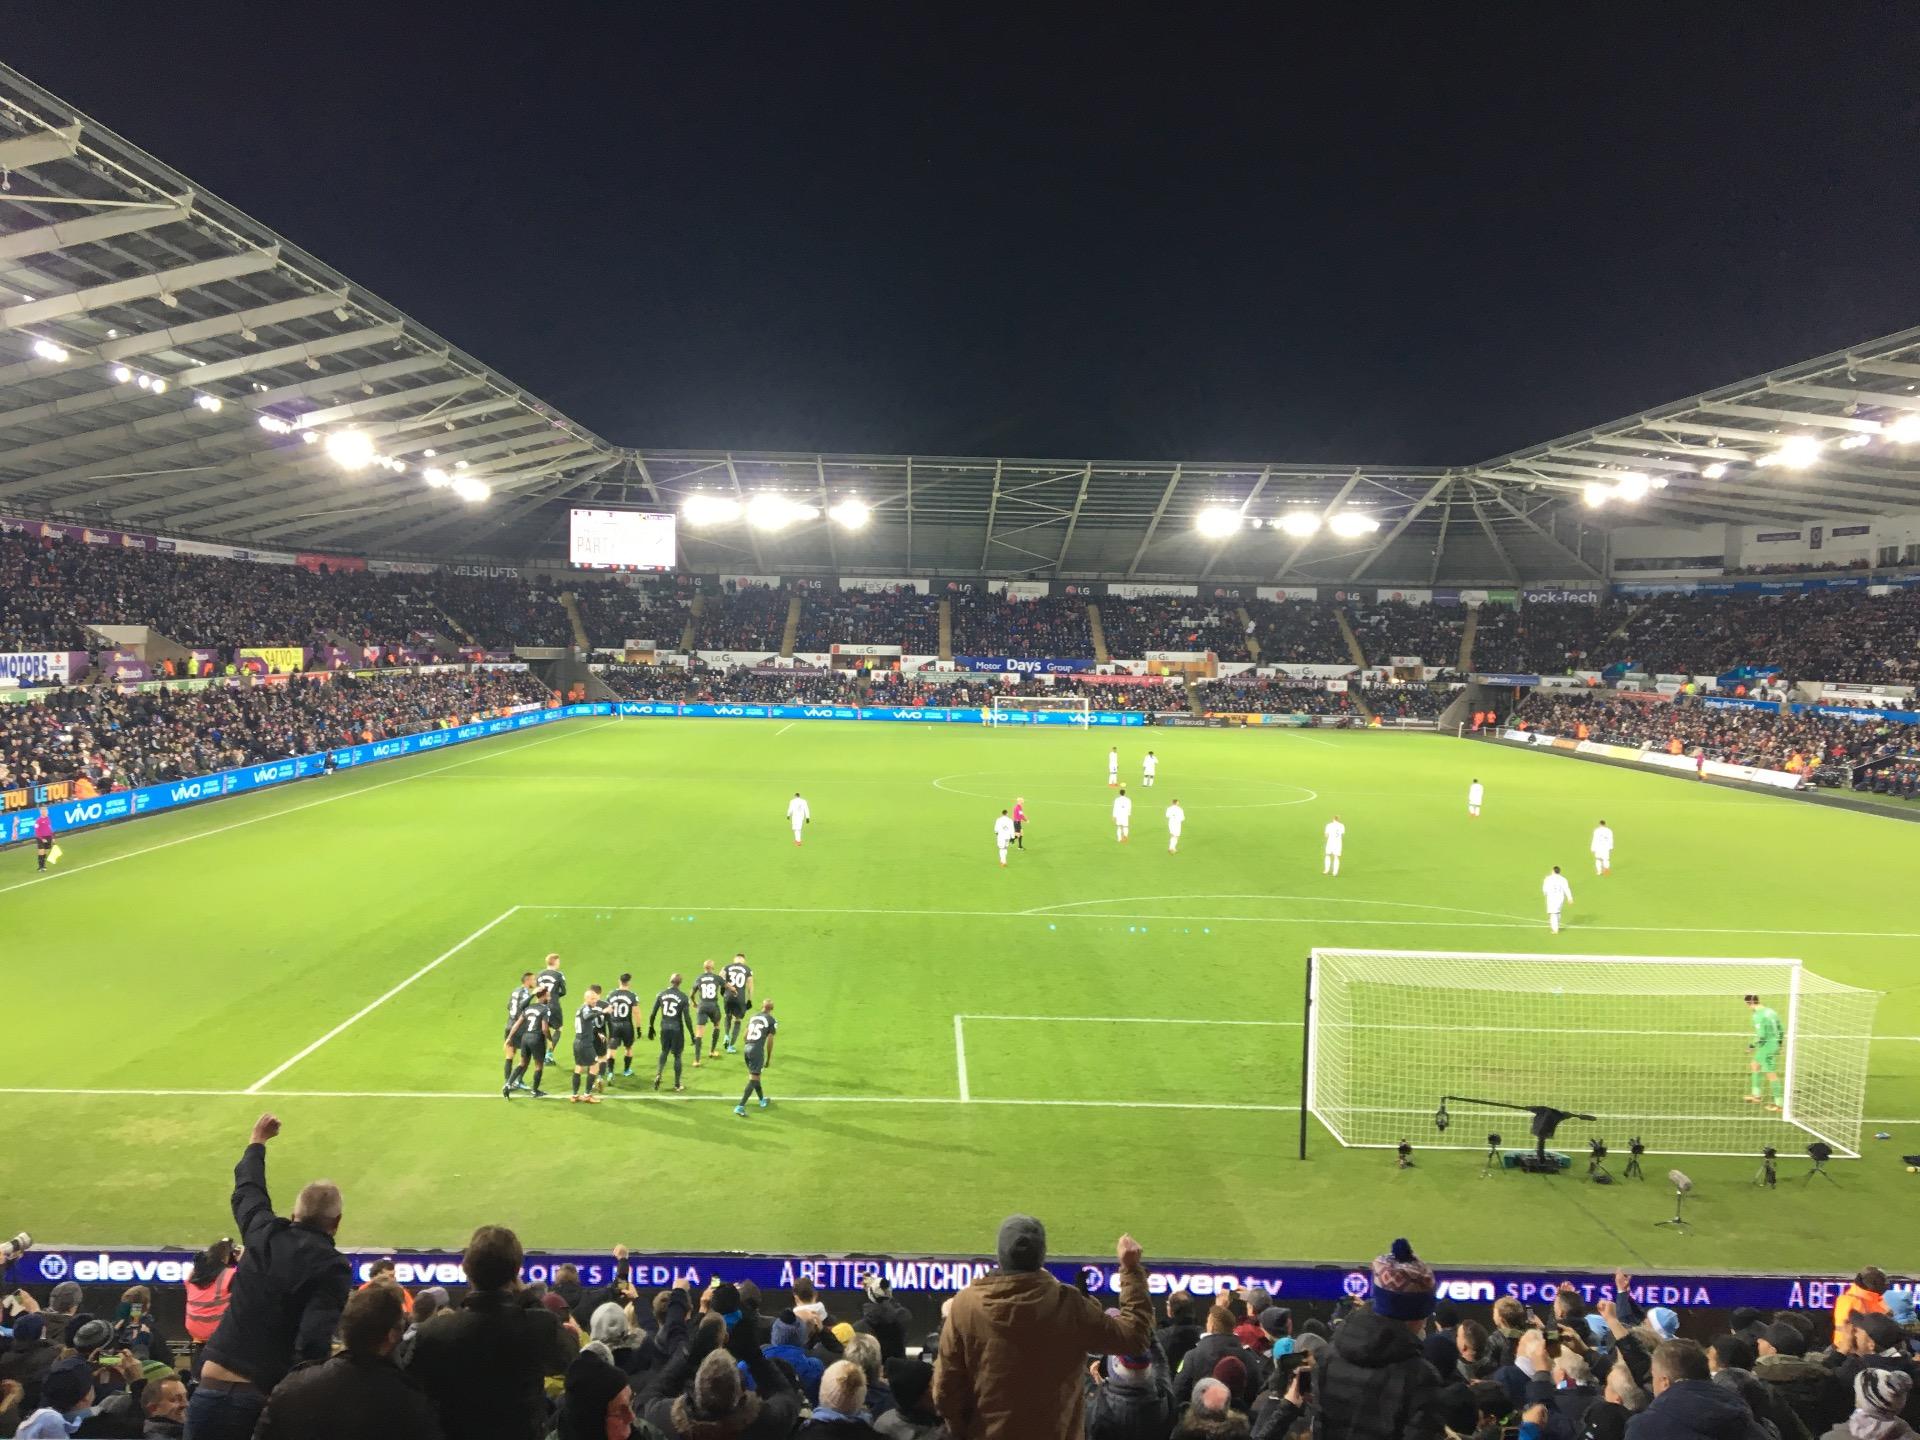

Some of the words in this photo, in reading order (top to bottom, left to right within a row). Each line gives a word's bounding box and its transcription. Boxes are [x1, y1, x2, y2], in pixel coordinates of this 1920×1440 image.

[809, 581, 821, 589] LG
[959, 584, 971, 592] LG
[1078, 587, 1090, 595] LG
[1347, 592, 1361, 601] LG
[0, 655, 47, 679] MOTORS
[976, 661, 1001, 670] Motor
[1007, 659, 1041, 673] Days
[1047, 664, 1073, 673] Group
[0, 790, 28, 810] ETOU
[728, 971, 746, 988] 30
[700, 983, 717, 999] 18
[613, 1002, 629, 1018] 10
[662, 1001, 678, 1017] 15
[527, 1015, 537, 1032] 7
[779, 1260, 794, 1288] A
[885, 1262, 999, 1290] MATCHDA
[1506, 1282, 1613, 1304] SPOTS
[1788, 1281, 1805, 1309] A
